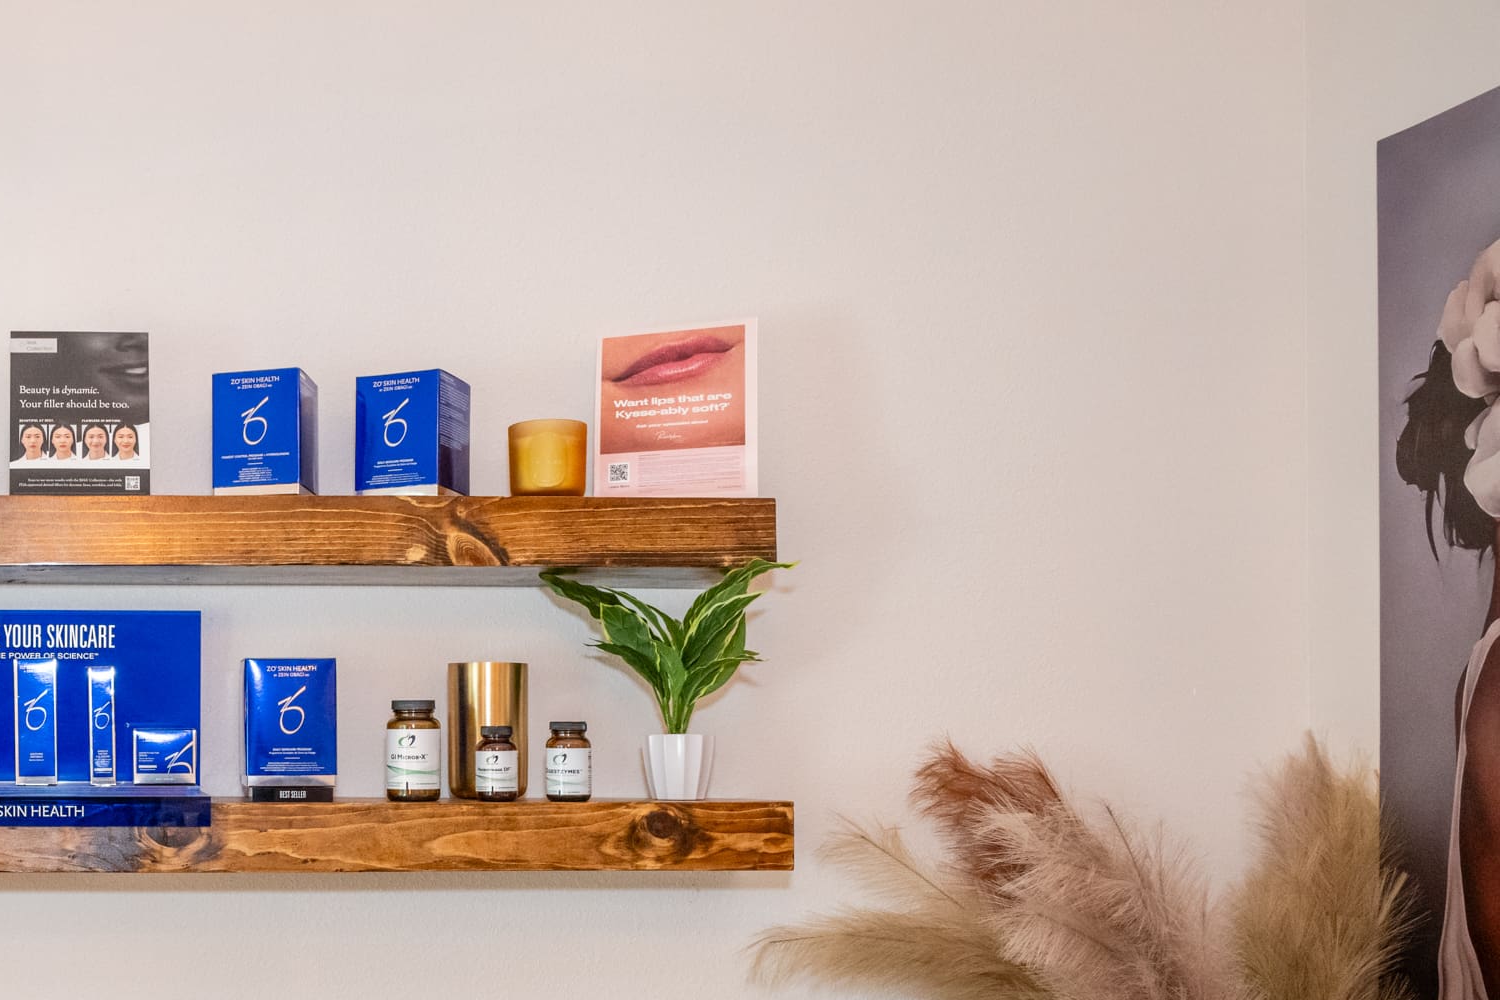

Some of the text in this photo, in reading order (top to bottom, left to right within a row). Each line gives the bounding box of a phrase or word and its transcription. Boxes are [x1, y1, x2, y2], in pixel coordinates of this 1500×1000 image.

[397, 377, 420, 385] HEALTH
[19, 385, 100, 396] Beauty is dynamic.
[19, 399, 130, 409] Your filler should be too.
[614, 393, 733, 408] Want lips that are
[615, 405, 690, 420] Kysse-ably
[3, 624, 42, 649] YOUR
[47, 624, 116, 649] SKINCARE
[8, 652, 40, 660] POWER
[280, 790, 307, 799] BEST SELLER
[31, 805, 85, 818] HEALTH
